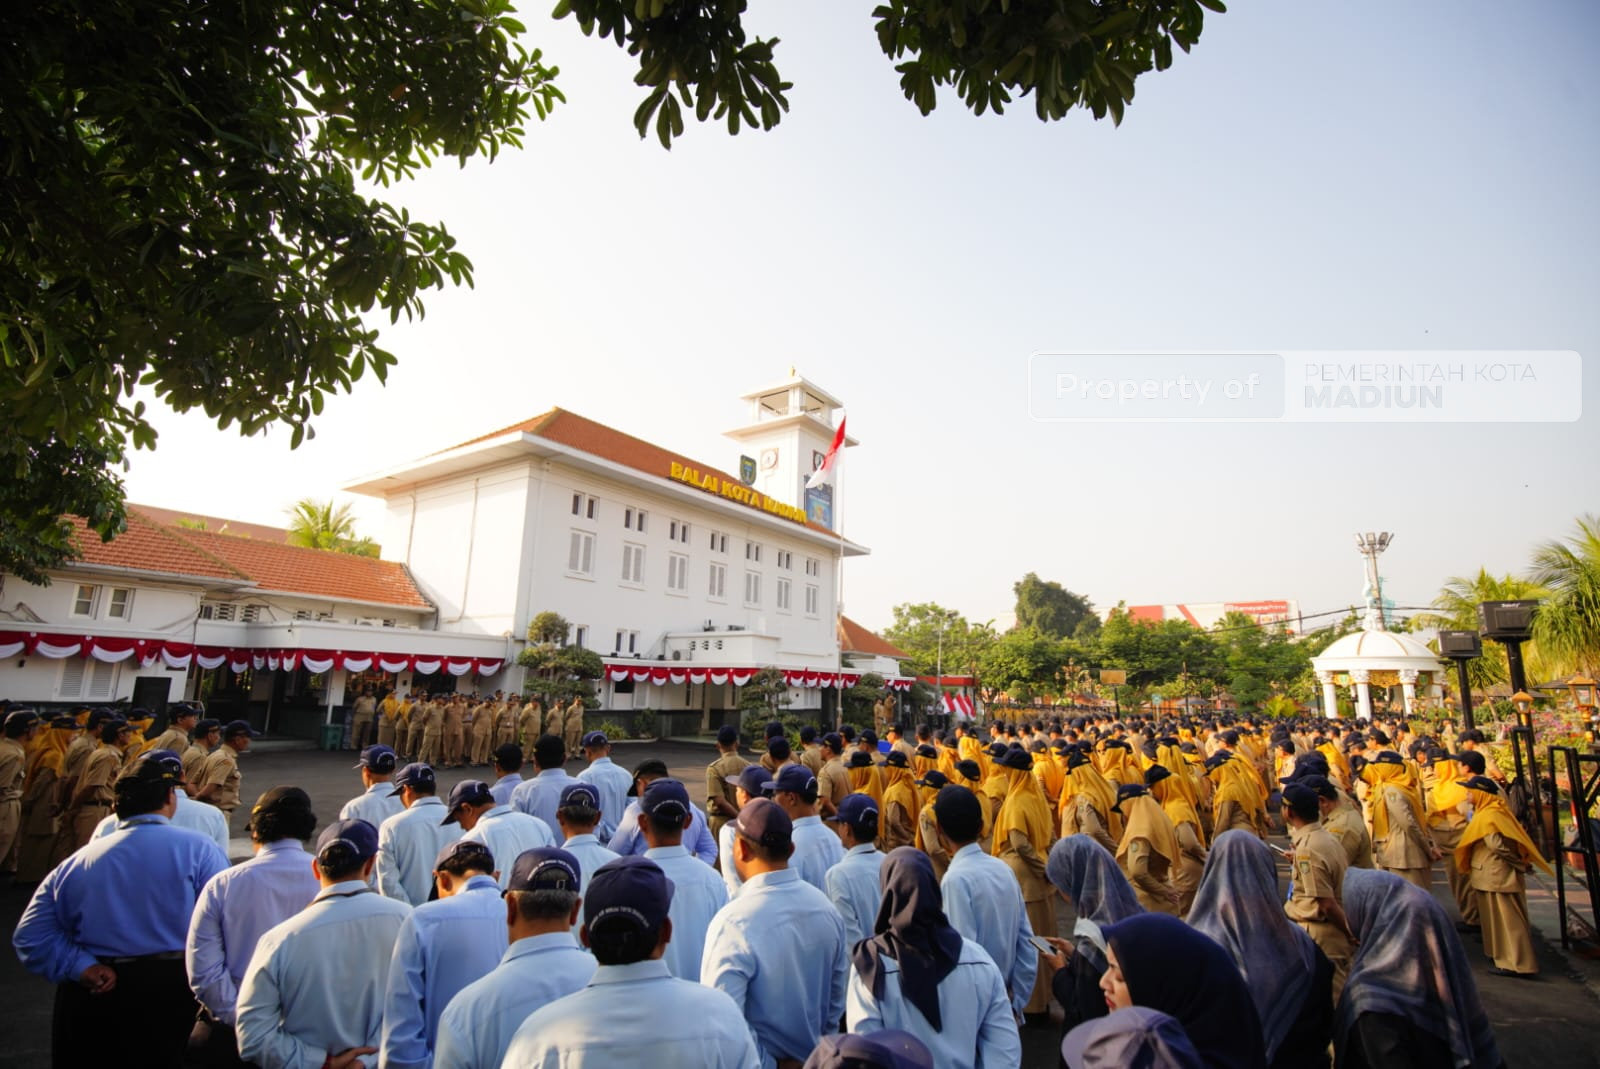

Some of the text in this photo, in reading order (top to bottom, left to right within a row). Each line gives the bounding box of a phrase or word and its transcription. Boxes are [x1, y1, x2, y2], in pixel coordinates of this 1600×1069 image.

[670, 461, 719, 492] BALAI
[721, 480, 761, 508] KOTA
[763, 495, 807, 523] MADIUN
